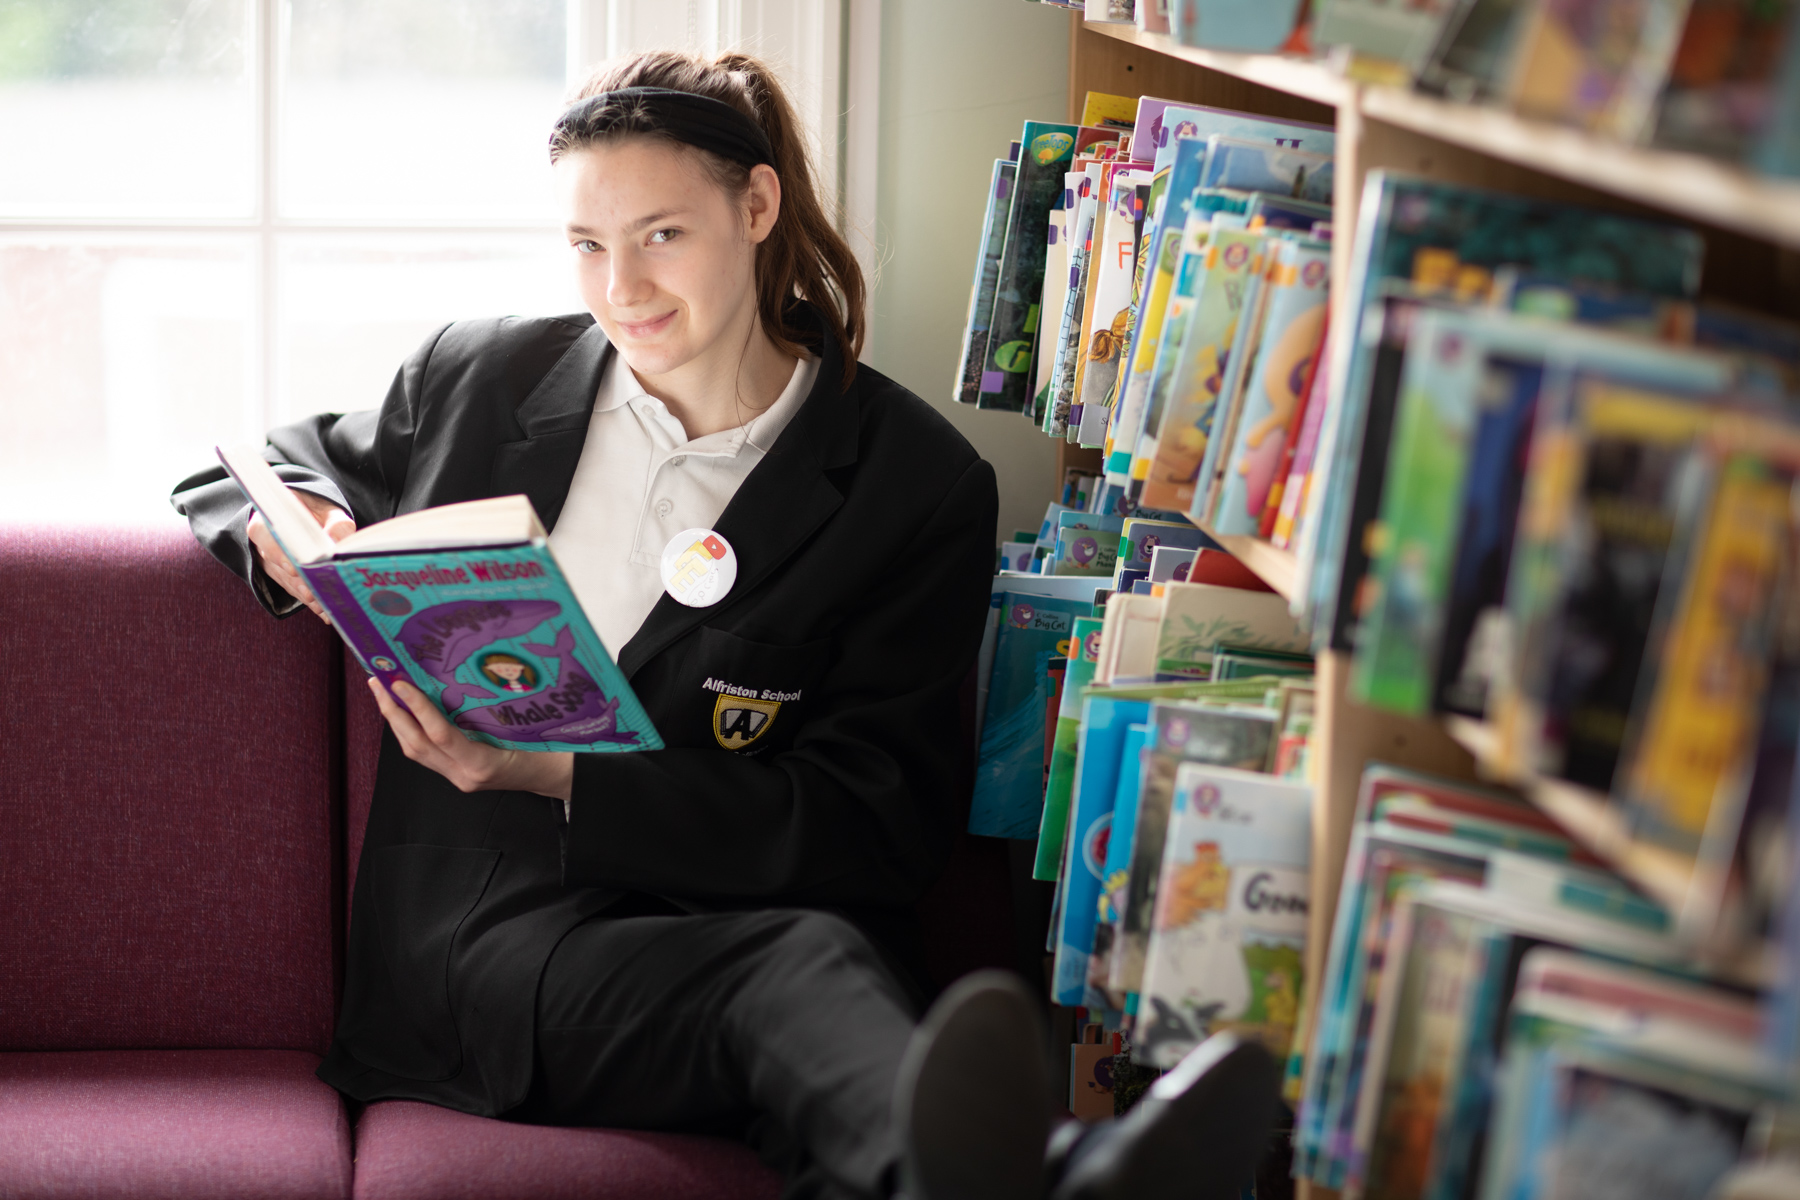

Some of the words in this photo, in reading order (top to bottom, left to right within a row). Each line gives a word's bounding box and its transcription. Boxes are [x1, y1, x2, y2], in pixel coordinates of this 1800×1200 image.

[1034, 134, 1069, 152] TreeTops
[355, 564, 471, 592] Jacqueline
[466, 560, 547, 583] Wilson
[1034, 618, 1050, 630] Big
[1051, 620, 1066, 631] Cat
[486, 701, 564, 726] Whale
[548, 671, 597, 713] Song
[702, 677, 758, 699] Alfriston
[760, 689, 802, 702] School
